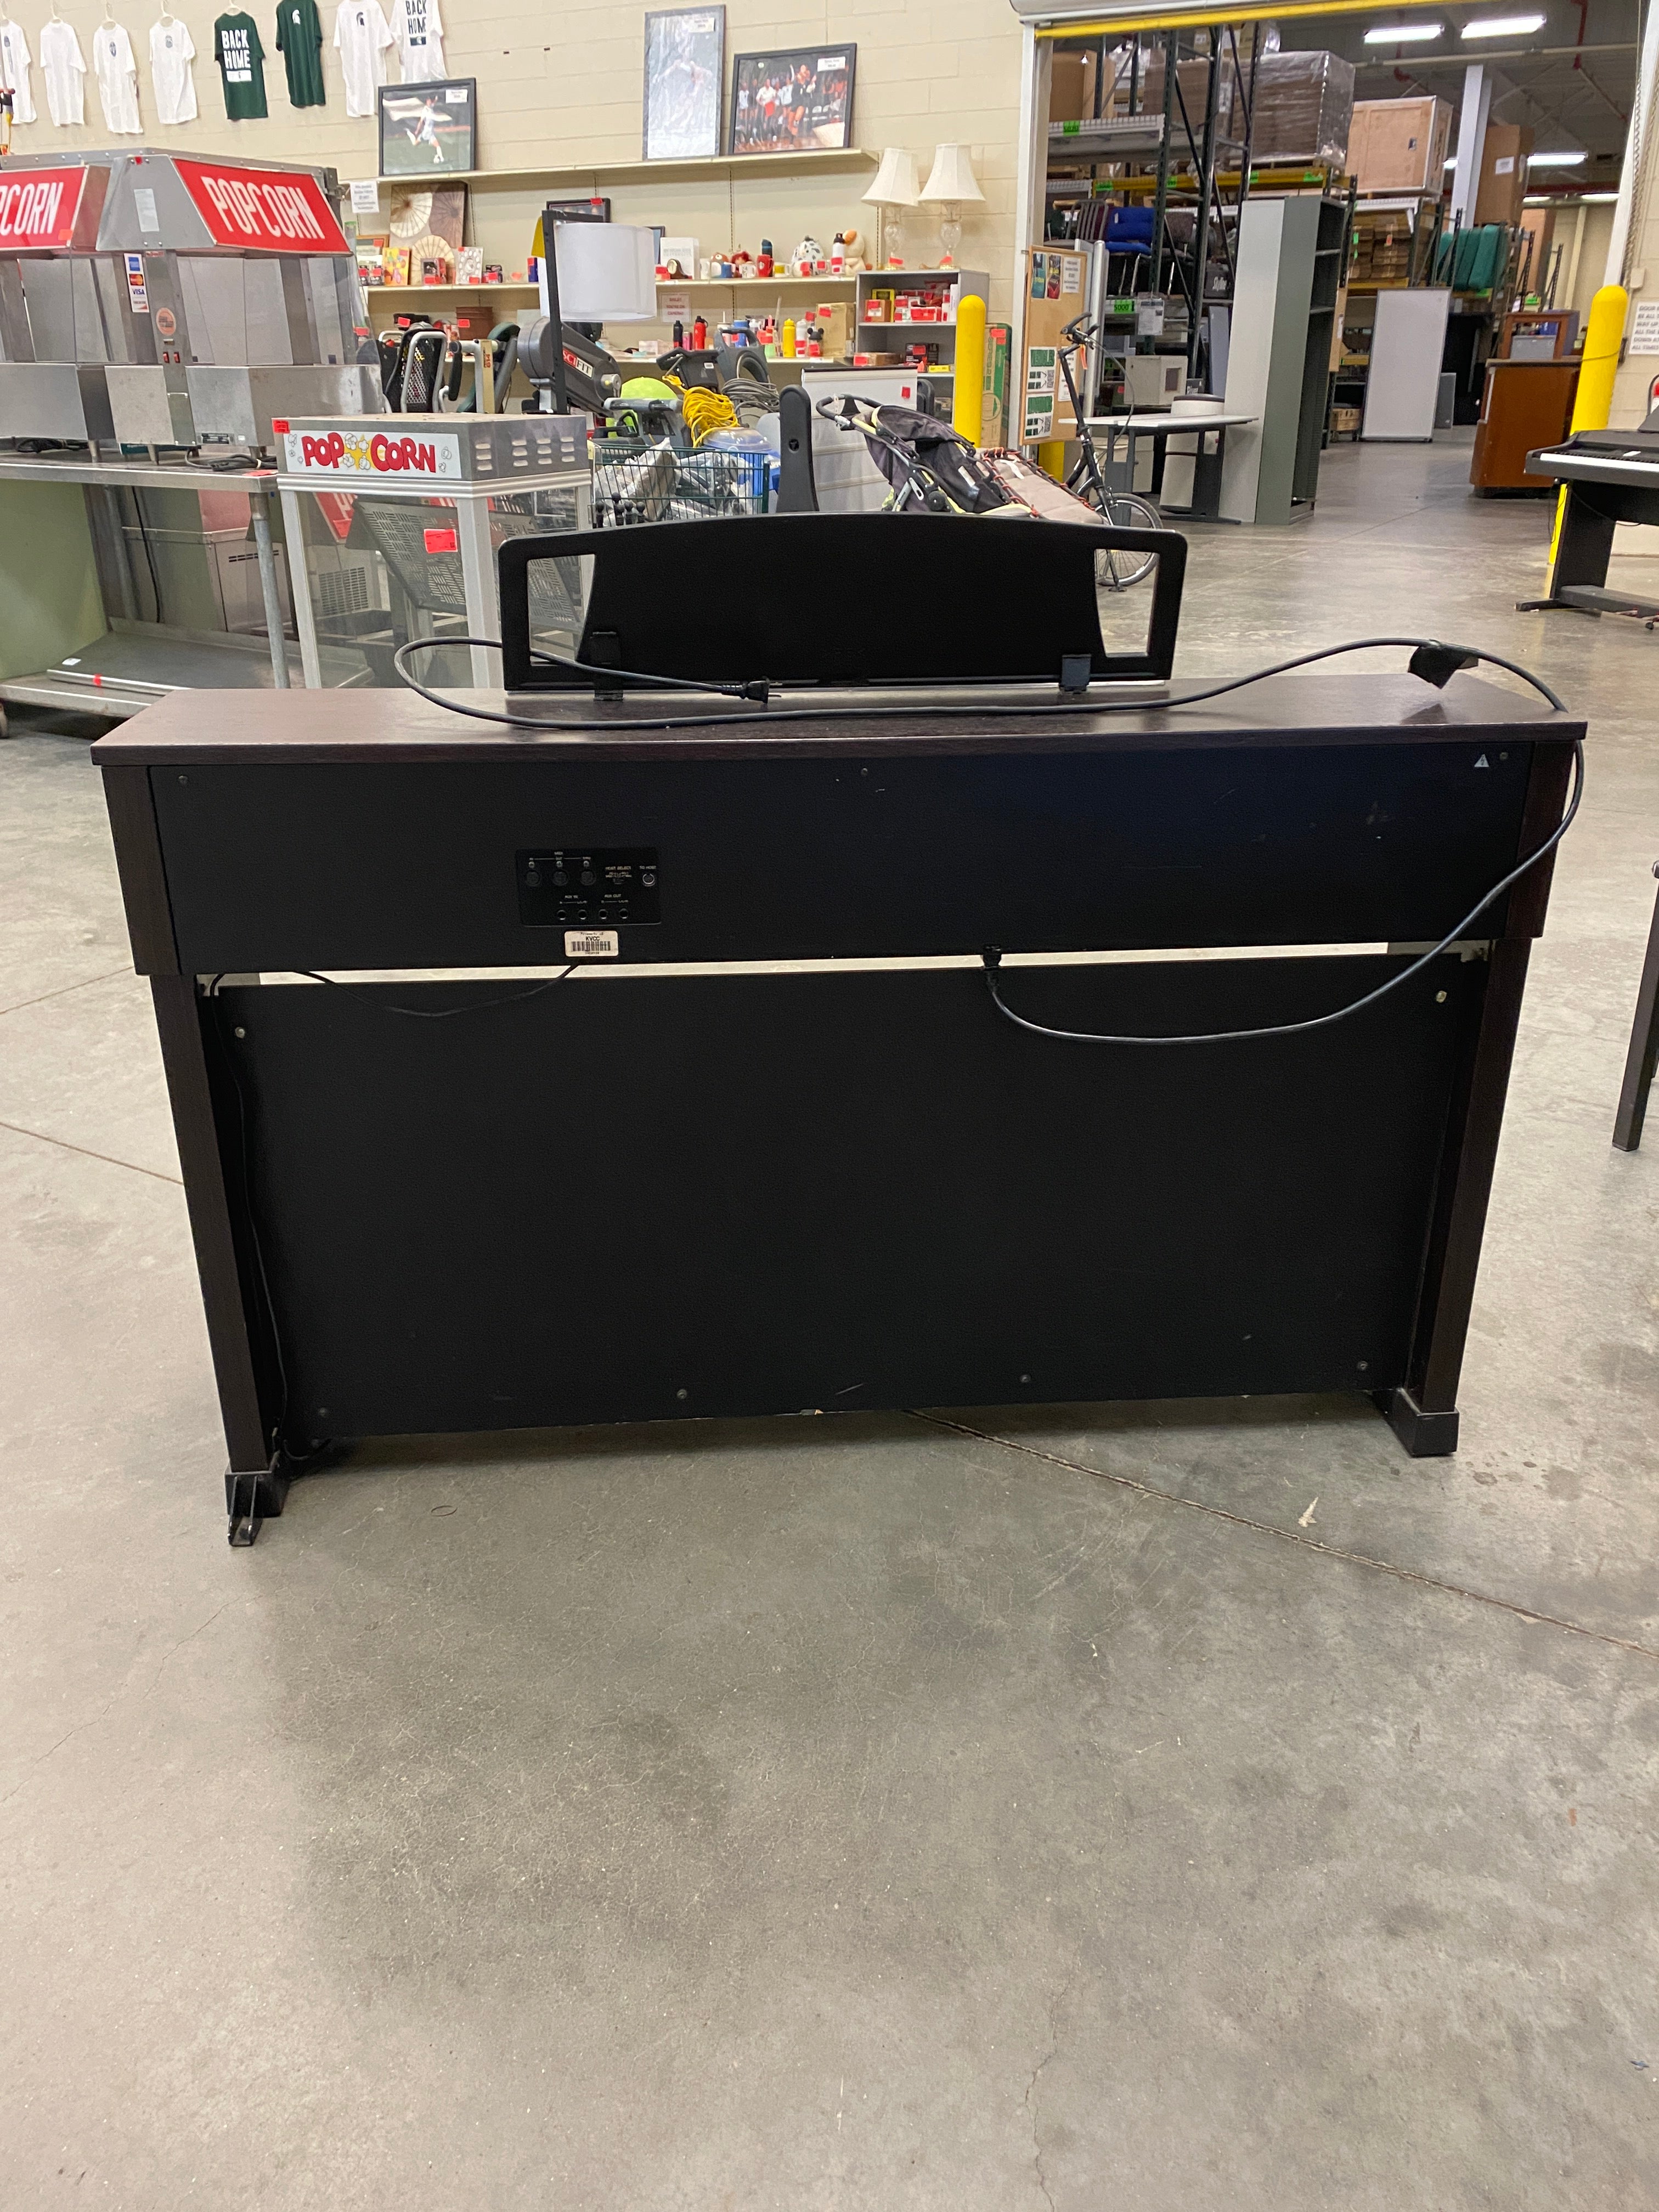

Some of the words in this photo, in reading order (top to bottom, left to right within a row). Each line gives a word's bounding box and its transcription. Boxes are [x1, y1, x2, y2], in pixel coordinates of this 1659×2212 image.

[405, 0, 426, 15] BACK
[221, 29, 250, 49] BACK
[223, 49, 251, 69] HOME
[200, 176, 325, 239] POPCORN
[301, 432, 345, 469] POP
[370, 433, 436, 473] CORN
